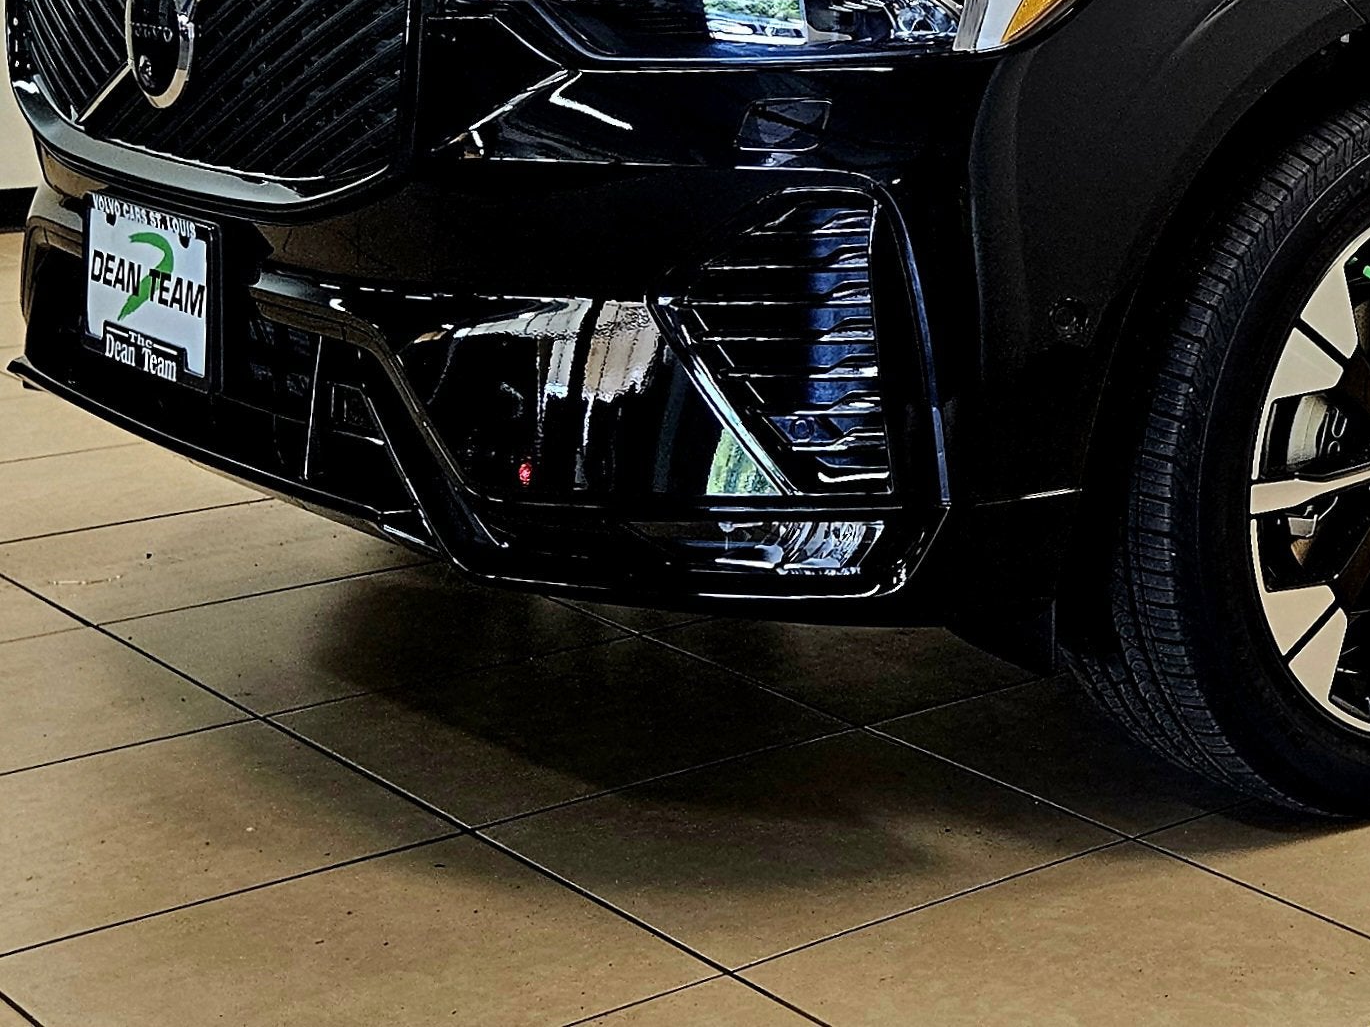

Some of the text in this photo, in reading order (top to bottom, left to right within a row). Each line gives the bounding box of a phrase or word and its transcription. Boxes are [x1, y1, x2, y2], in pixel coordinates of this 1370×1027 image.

[91, 193, 120, 217] VOLVO
[122, 202, 148, 224] CARS
[165, 216, 196, 238] LOUIS
[91, 250, 205, 318] DEAN TEAM
[105, 333, 177, 382] Dean Team
[129, 331, 153, 349] The
